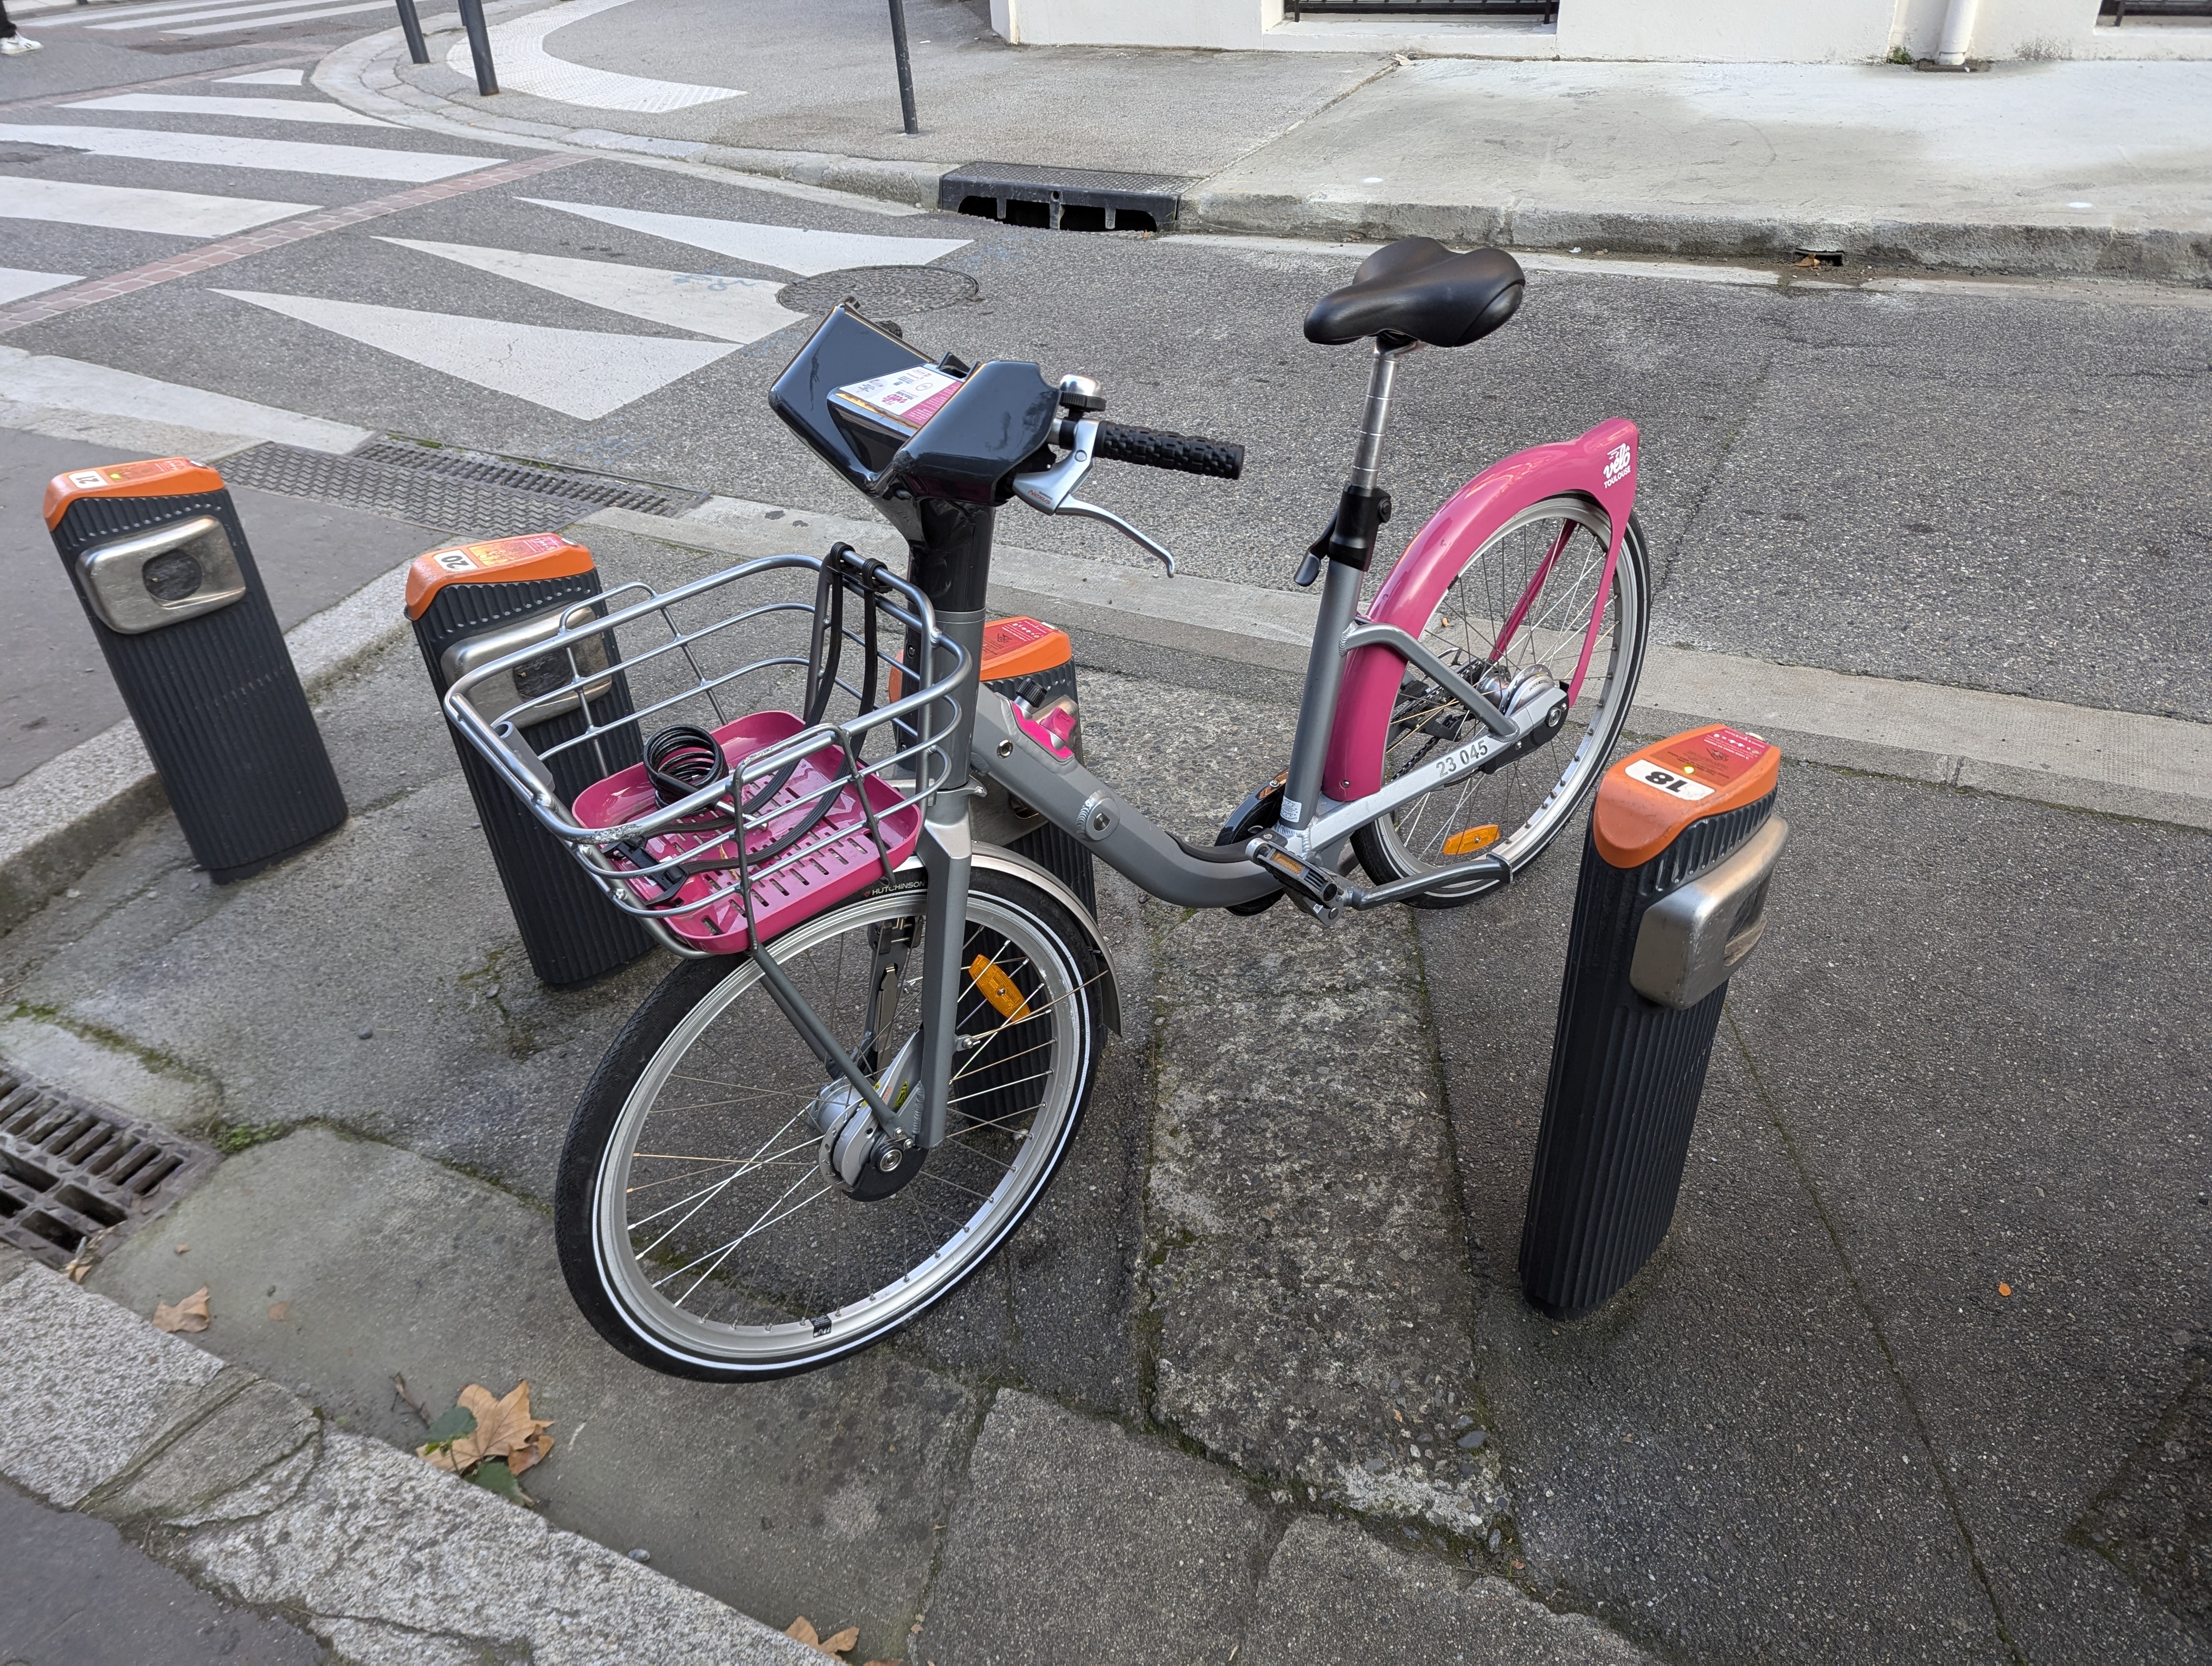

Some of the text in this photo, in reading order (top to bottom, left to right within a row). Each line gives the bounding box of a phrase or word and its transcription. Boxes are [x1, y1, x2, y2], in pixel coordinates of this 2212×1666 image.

[76, 475, 100, 484] 21
[1604, 465, 1631, 489] TOULOUSE
[441, 555, 470, 570] 20
[1436, 739, 1488, 779] 23 045
[1645, 771, 1688, 792] 18
[872, 881, 925, 896] HUTCHINSON
